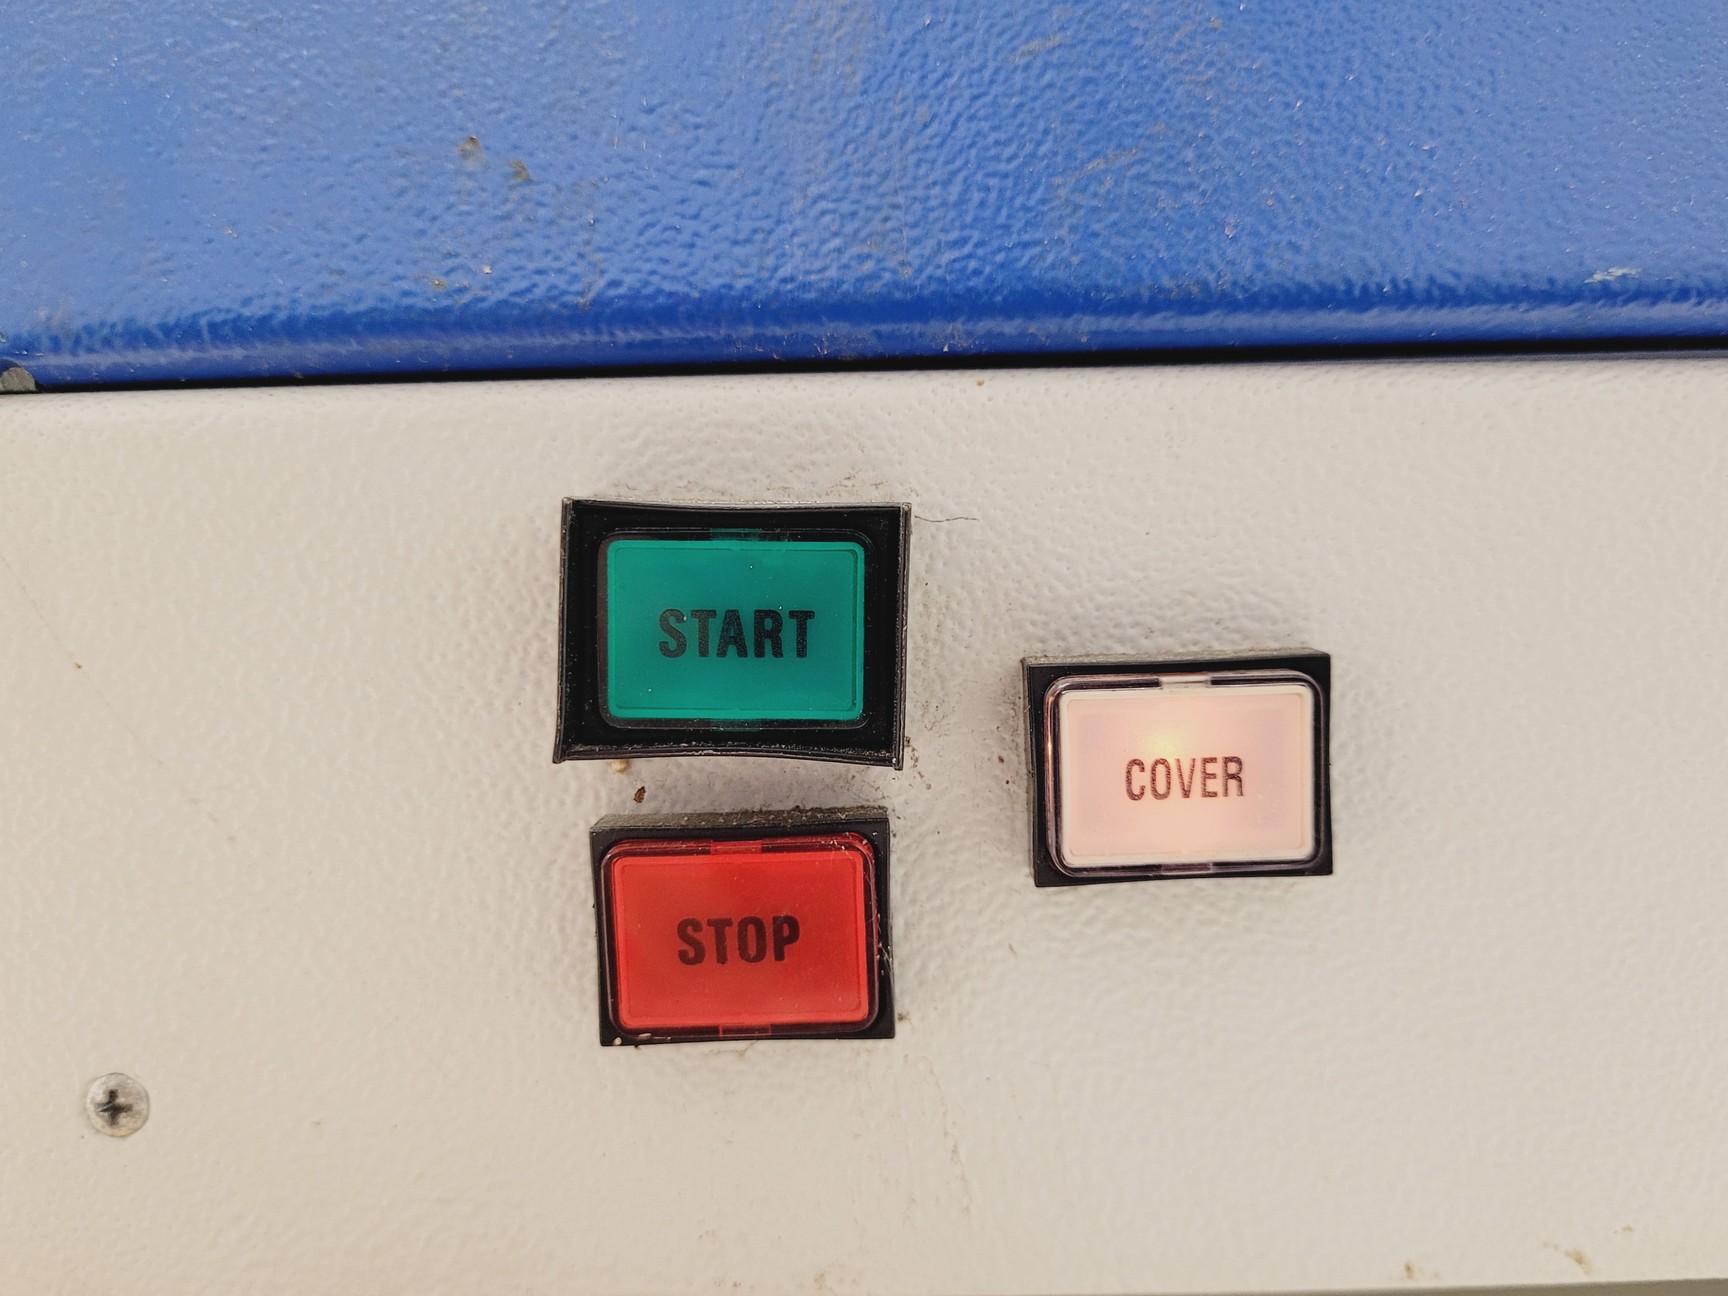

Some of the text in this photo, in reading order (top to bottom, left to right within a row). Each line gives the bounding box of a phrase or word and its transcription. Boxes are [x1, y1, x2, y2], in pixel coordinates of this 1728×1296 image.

[658, 608, 815, 659] START
[1125, 755, 1246, 802] COVER
[676, 914, 801, 966] STOP
